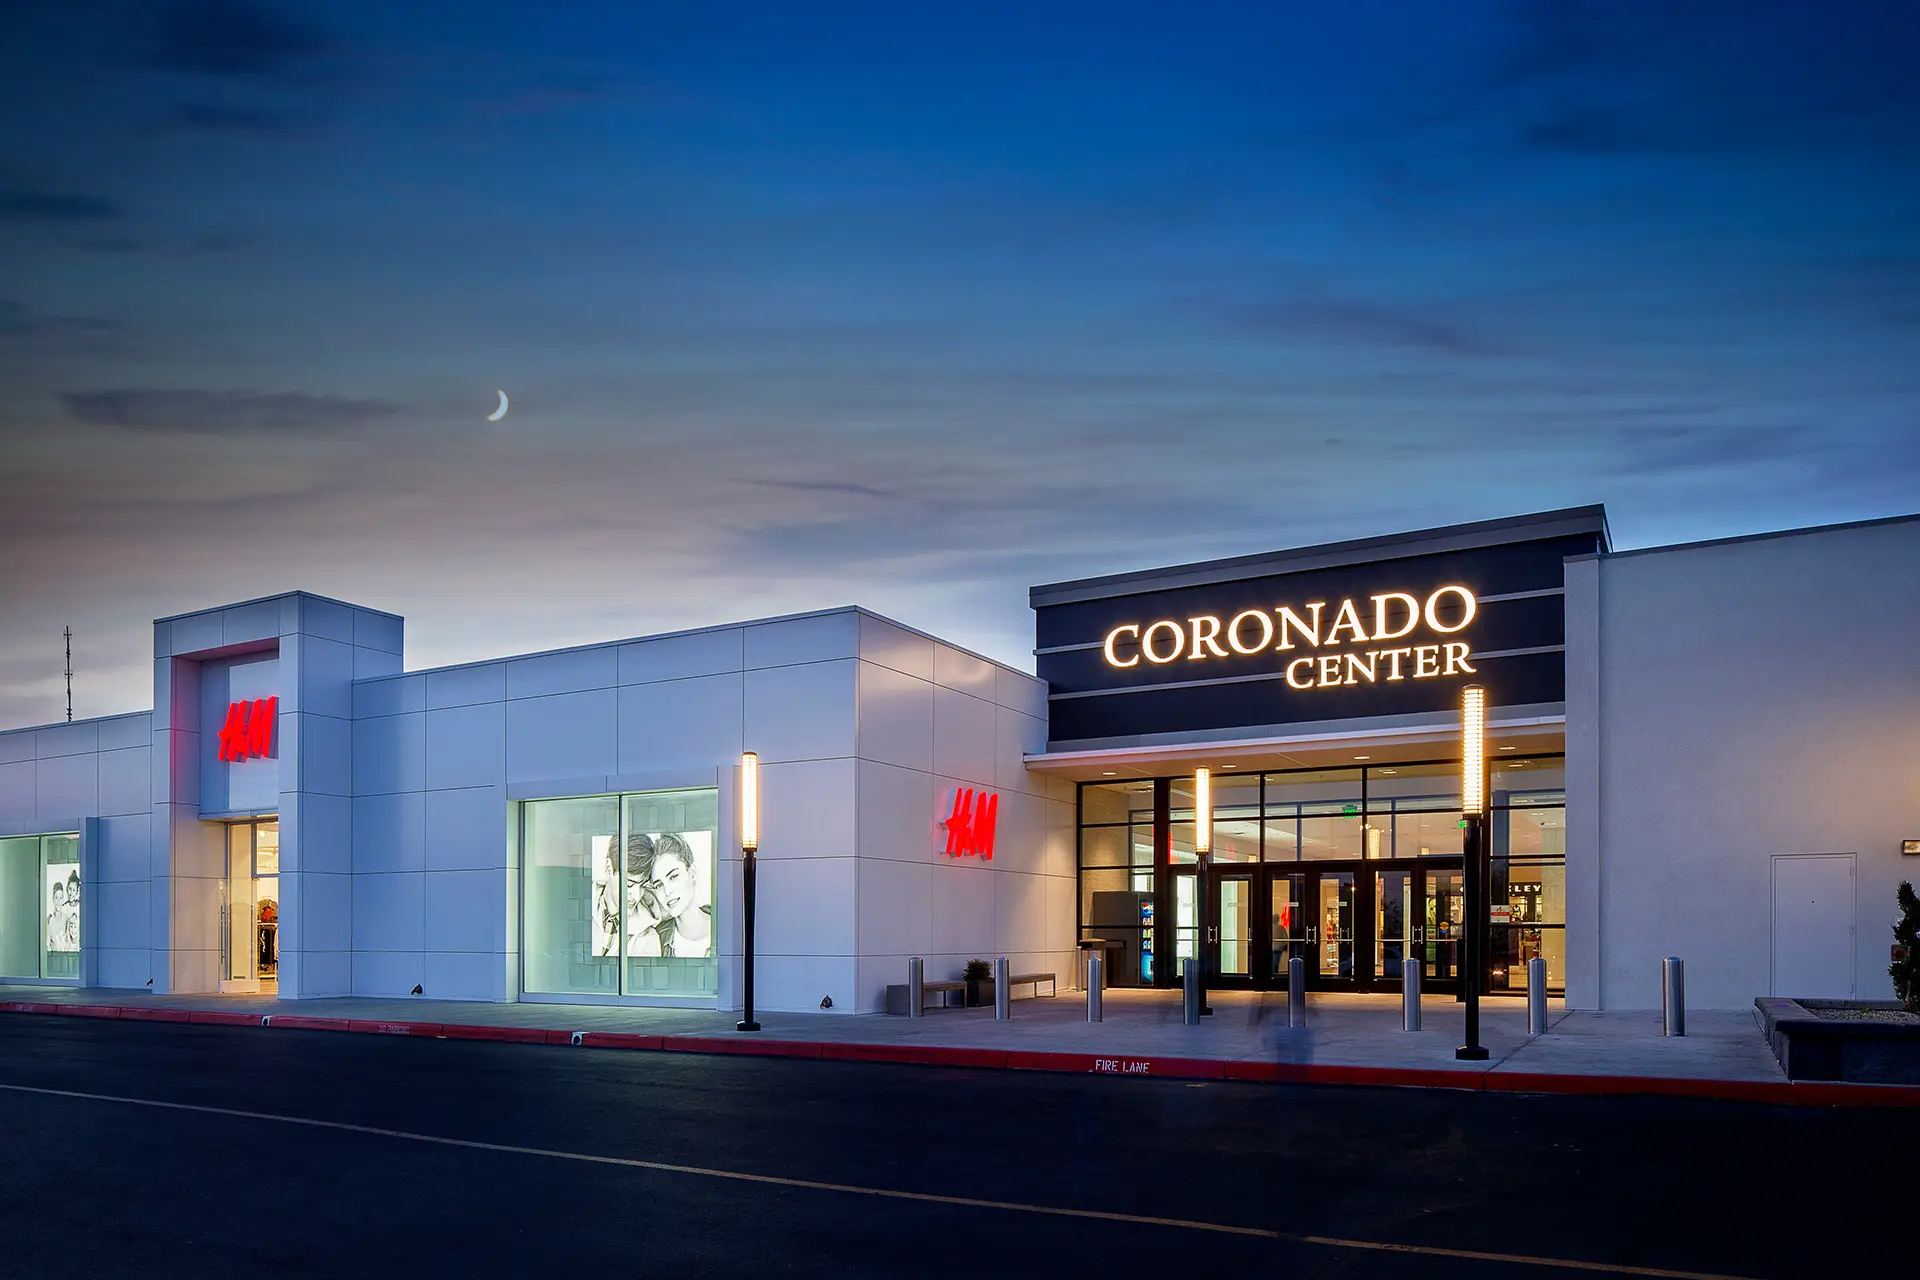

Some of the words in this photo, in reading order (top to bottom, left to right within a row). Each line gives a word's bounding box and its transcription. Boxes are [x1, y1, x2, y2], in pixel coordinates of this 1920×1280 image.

[1103, 585, 1477, 668] CORONADO
[1285, 642, 1477, 690] CENTER
[217, 694, 278, 763] H&M
[944, 787, 999, 861] H&M
[1095, 1059, 1119, 1072] FIRE
[1122, 1061, 1150, 1073] LANE
